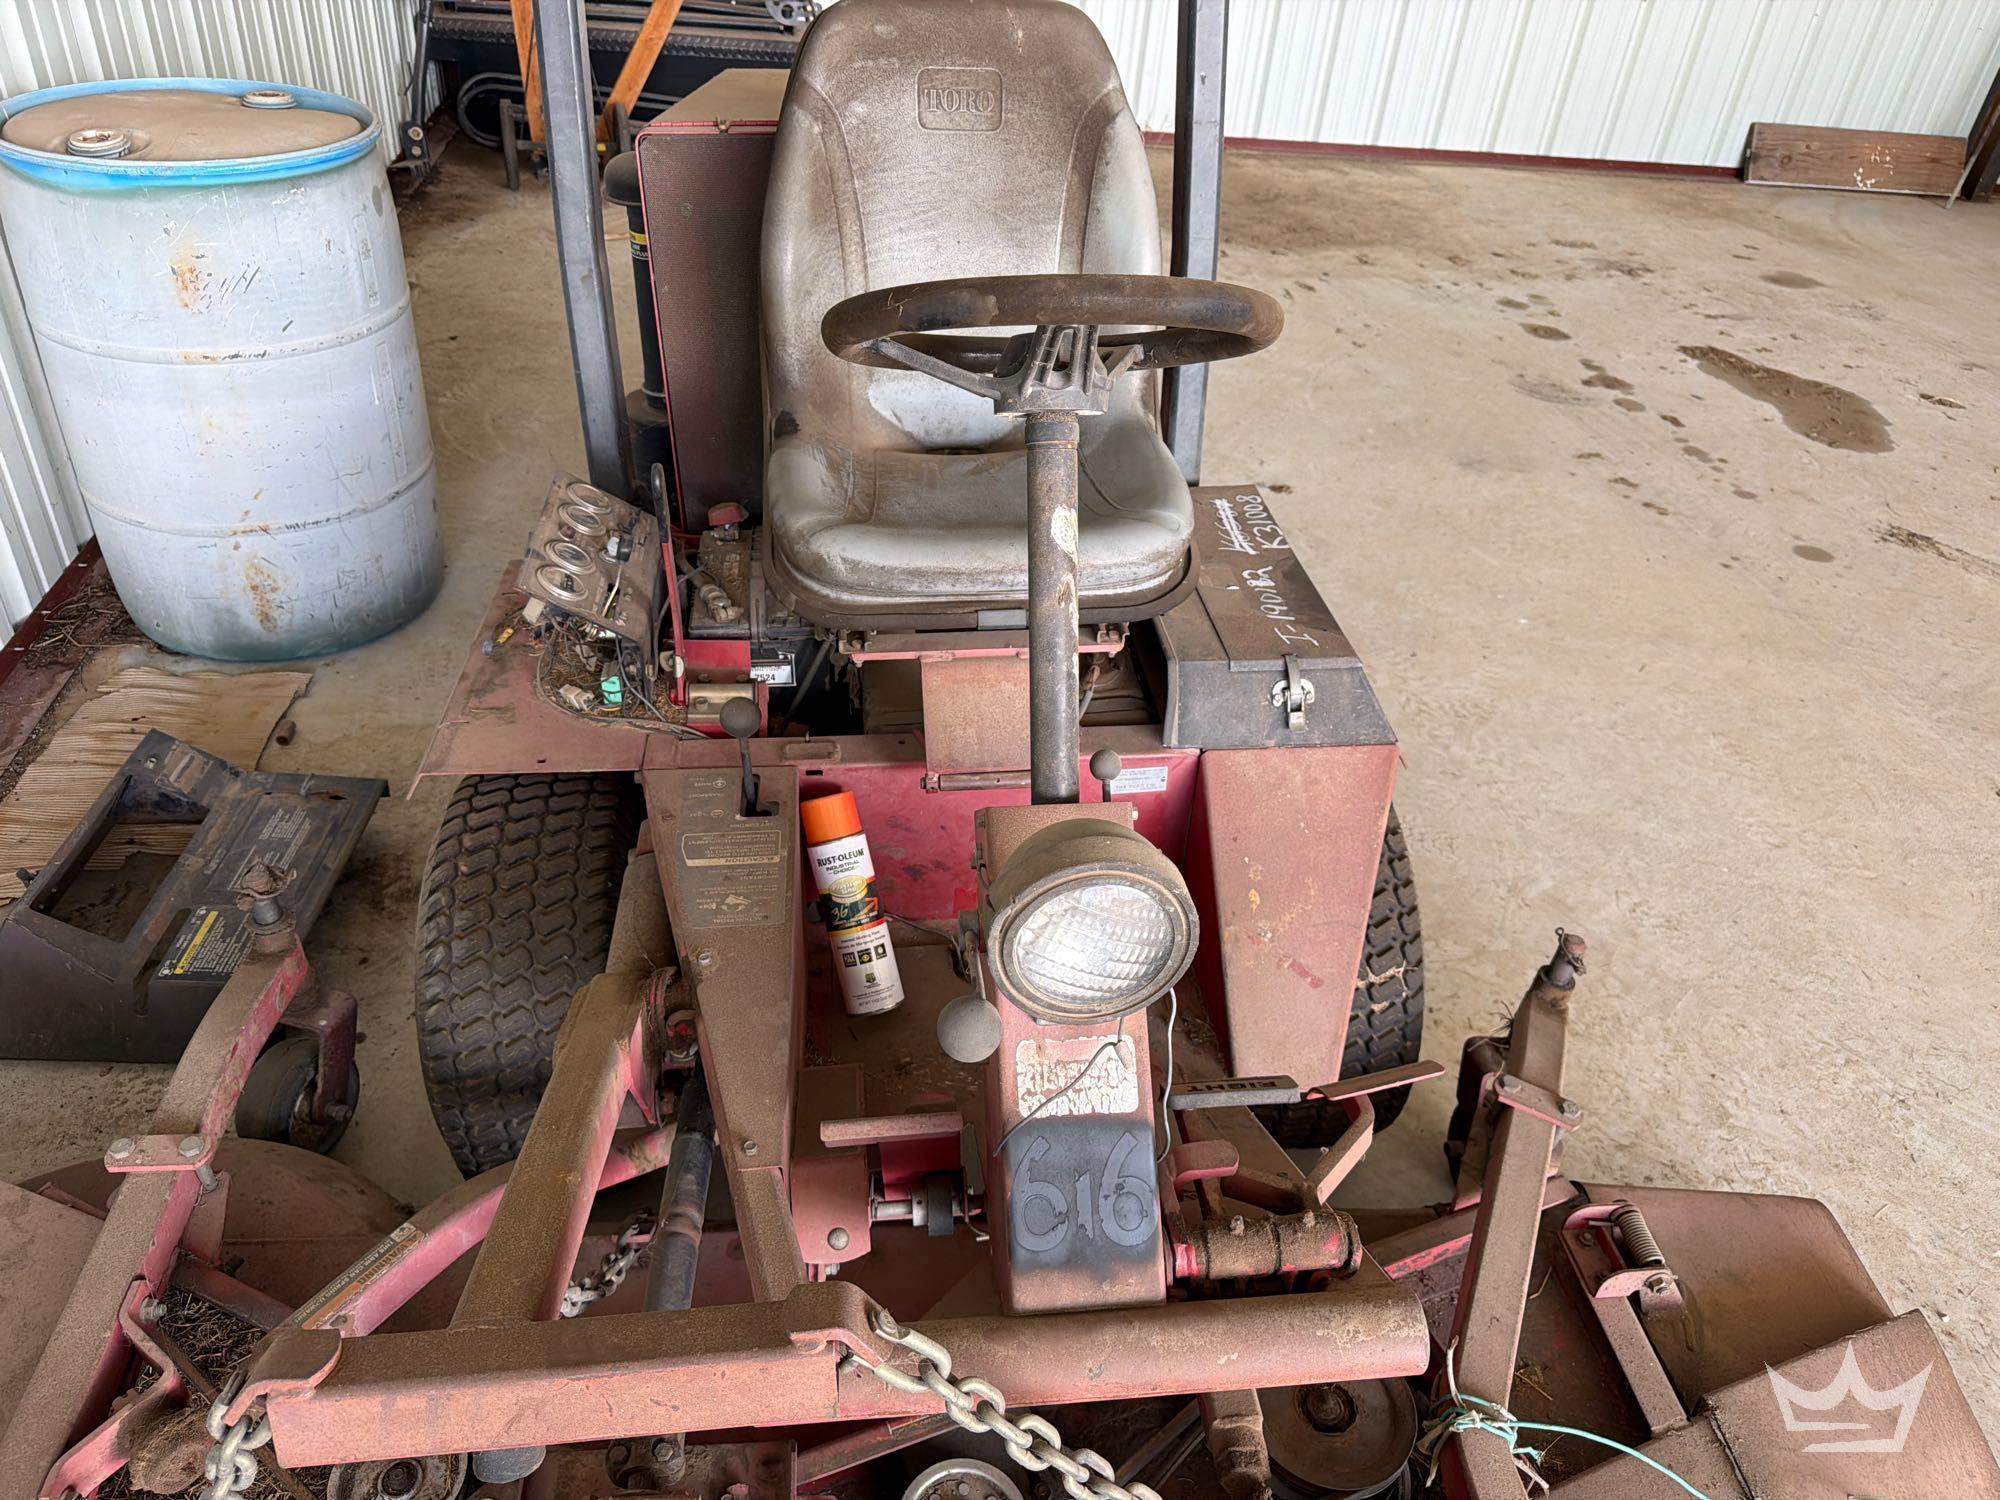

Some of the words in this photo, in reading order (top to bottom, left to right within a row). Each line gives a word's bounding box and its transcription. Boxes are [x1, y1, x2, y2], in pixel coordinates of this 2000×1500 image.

[923, 88, 995, 113] TORO
[1236, 494, 1291, 549] K31008
[725, 856, 764, 864] CAUTION
[817, 848, 865, 867] RUST-OLEUM
[826, 860, 860, 872] INDUSTRIAL
[1187, 1081, 1277, 1093] RIGHT
[1010, 1131, 1159, 1252] 616
[358, 1241, 412, 1284] WARNING
